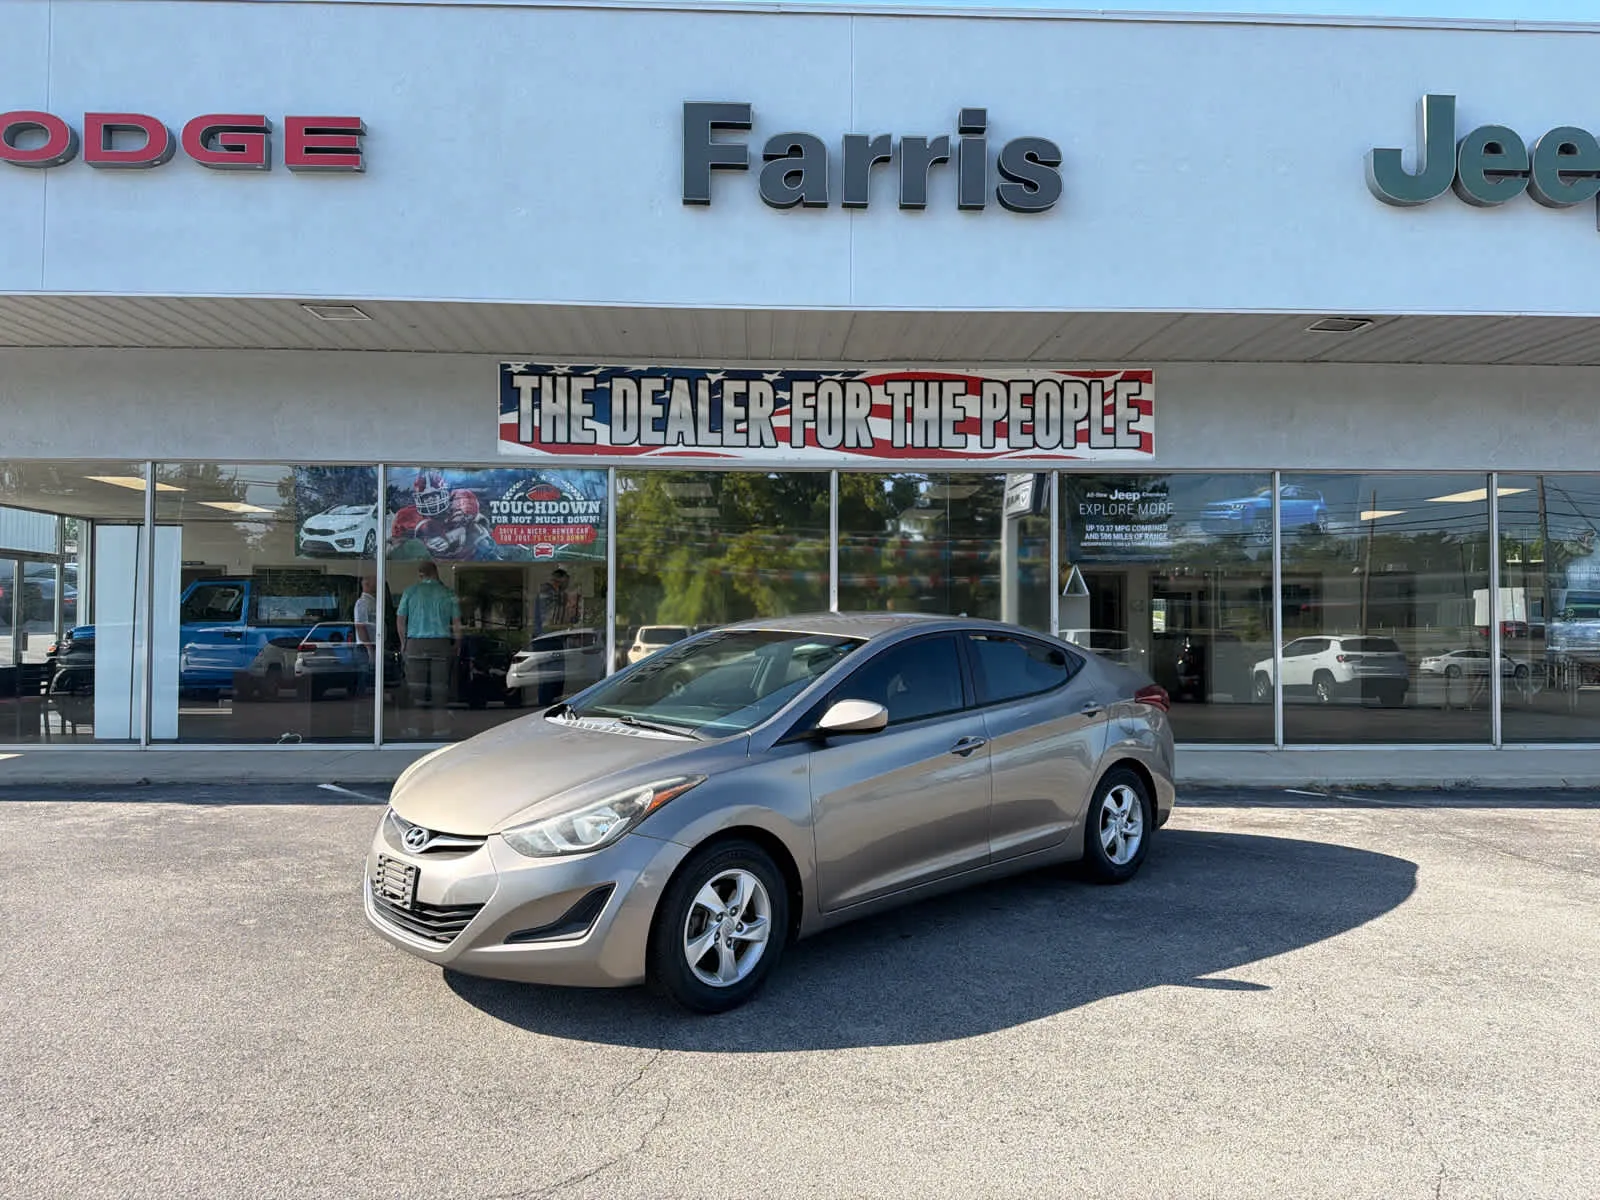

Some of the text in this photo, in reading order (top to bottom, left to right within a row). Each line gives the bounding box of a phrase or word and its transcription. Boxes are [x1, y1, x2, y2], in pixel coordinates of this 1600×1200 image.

[683, 101, 1063, 212] Farris
[1365, 94, 1600, 232] Jee
[511, 374, 1143, 450] THE DEALER FOR THE PEOPLE
[1109, 489, 1140, 502] Jeep
[490, 500, 600, 514] TOUCHDOWN
[1080, 503, 1133, 515] EXPLORE
[492, 516, 600, 524] FOR NOT MUCH DOWN!
